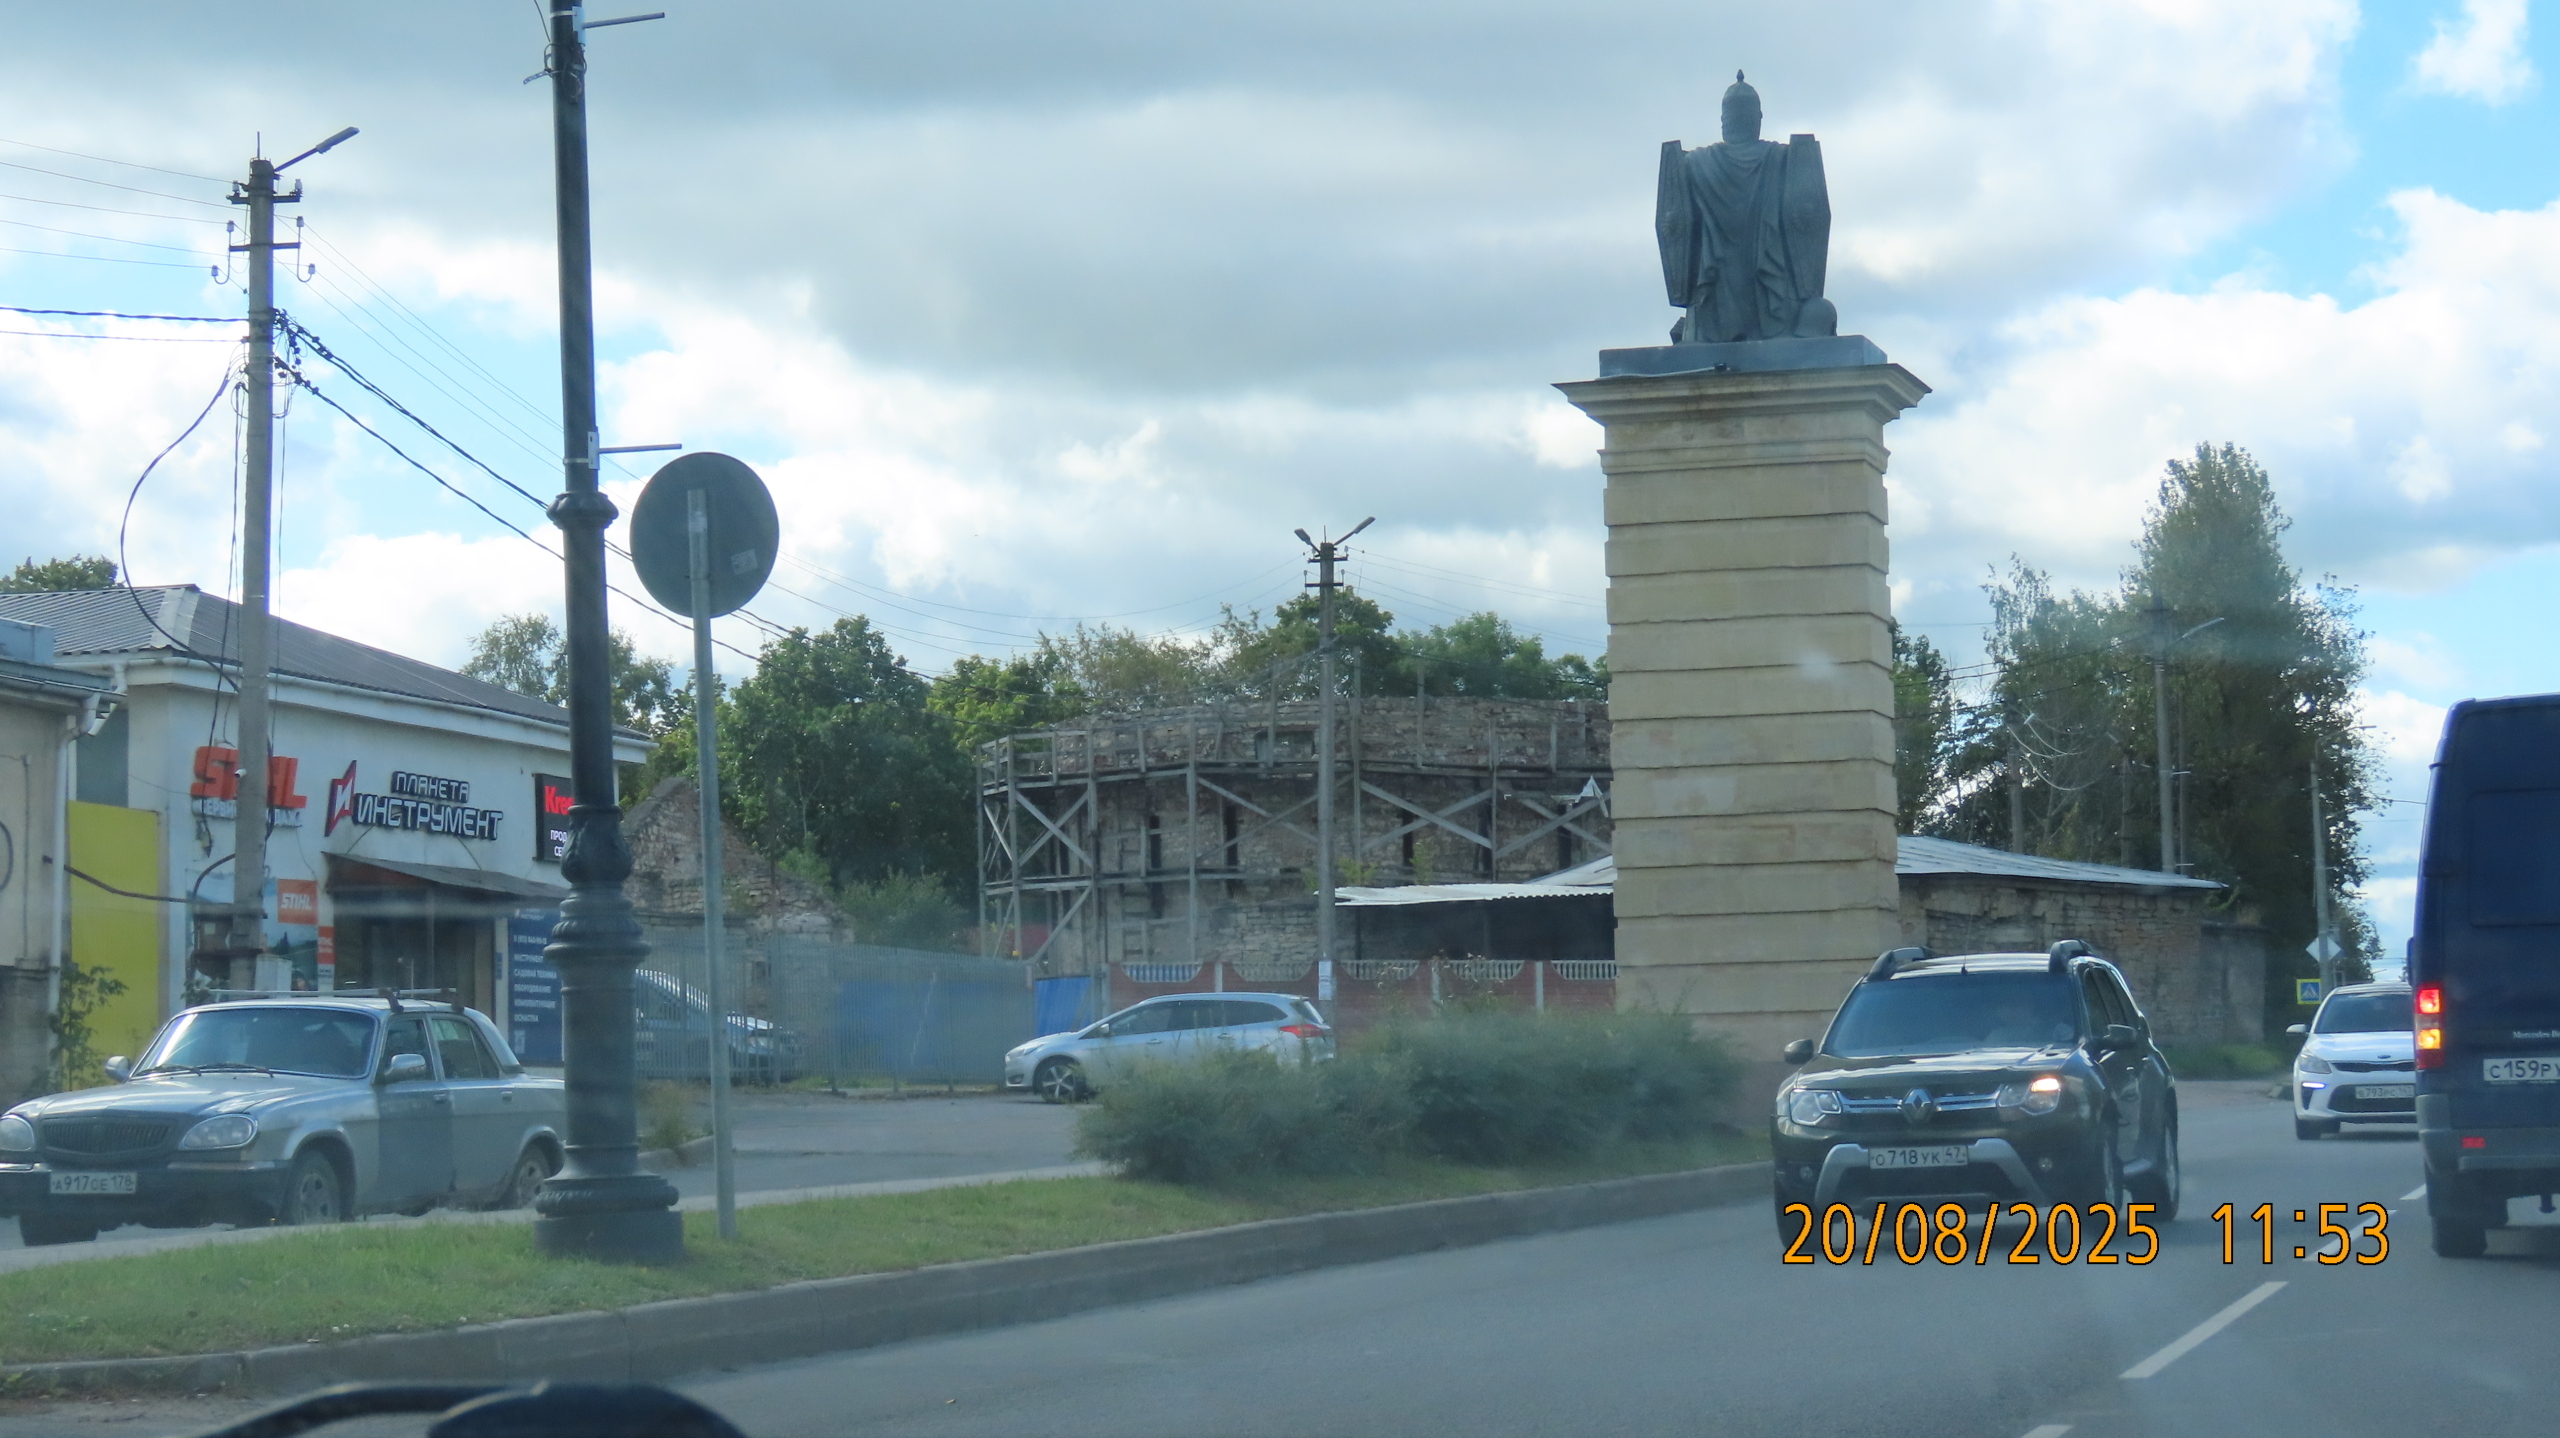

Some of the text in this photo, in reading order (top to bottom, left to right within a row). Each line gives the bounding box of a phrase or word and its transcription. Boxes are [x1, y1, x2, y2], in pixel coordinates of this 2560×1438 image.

[394, 771, 470, 802] ПЛАНЕТА
[355, 794, 503, 839] ИНСТРУМЕНТ
[281, 892, 312, 910] STIHL
